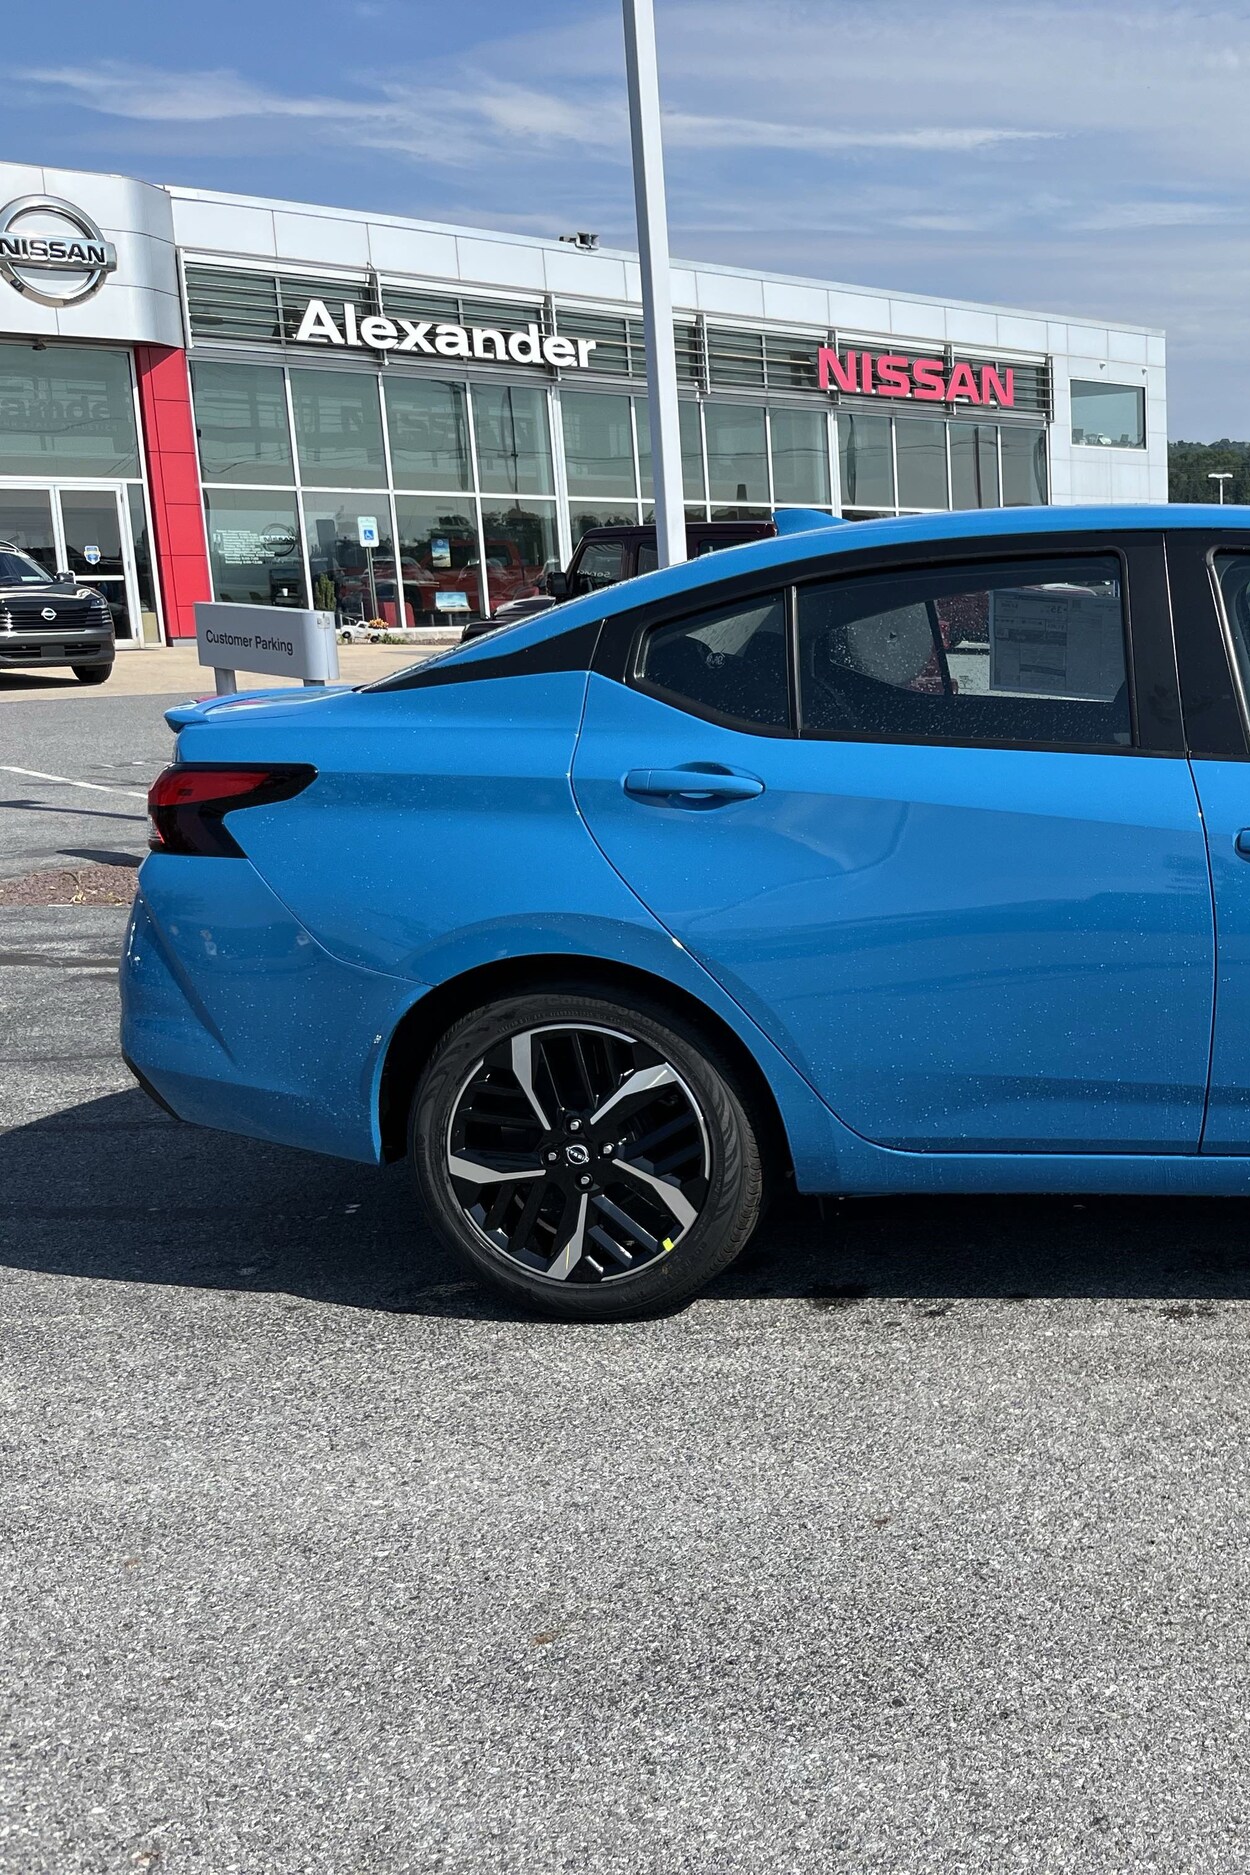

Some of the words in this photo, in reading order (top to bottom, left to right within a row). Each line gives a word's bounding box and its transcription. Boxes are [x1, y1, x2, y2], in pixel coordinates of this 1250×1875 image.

[0, 237, 105, 264] NISSAN
[296, 299, 597, 368] Alexander
[817, 346, 1014, 407] NISSAN
[206, 629, 253, 648] Customer
[254, 635, 294, 656] Parking
